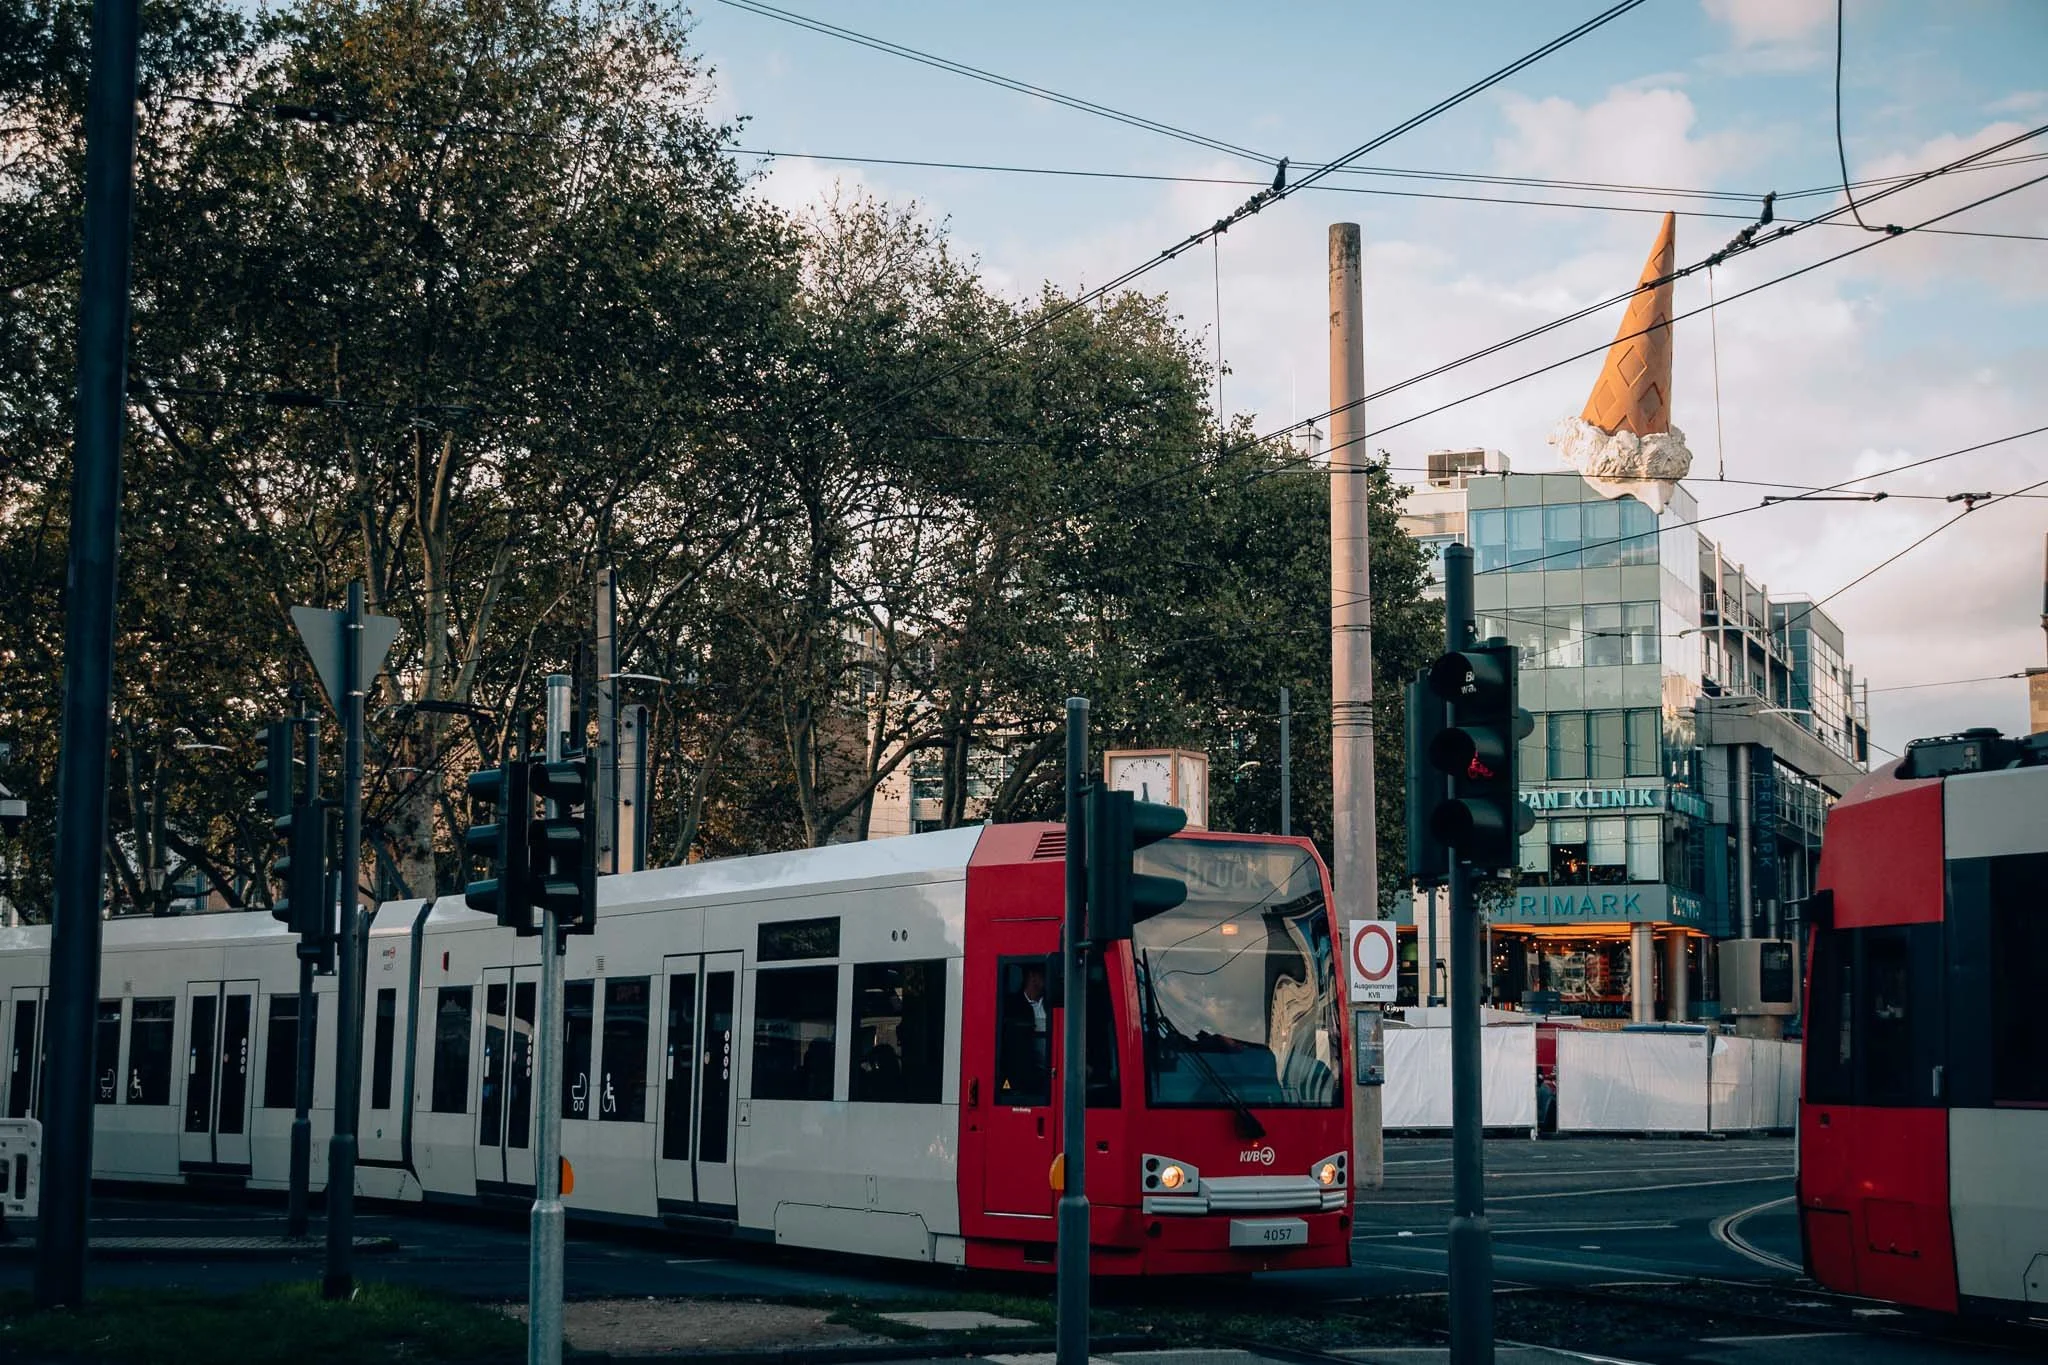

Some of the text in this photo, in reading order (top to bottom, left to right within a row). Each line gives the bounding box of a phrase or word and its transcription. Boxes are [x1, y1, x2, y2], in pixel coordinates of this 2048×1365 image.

[1571, 790, 1653, 808] KLINIK
[1757, 777, 1774, 869] PRIMARK
[1354, 982, 1395, 991] Ausgenommen
[1368, 991, 1381, 999] KVB
[1240, 1151, 1260, 1162] KVB
[1263, 1229, 1292, 1241] 4057
